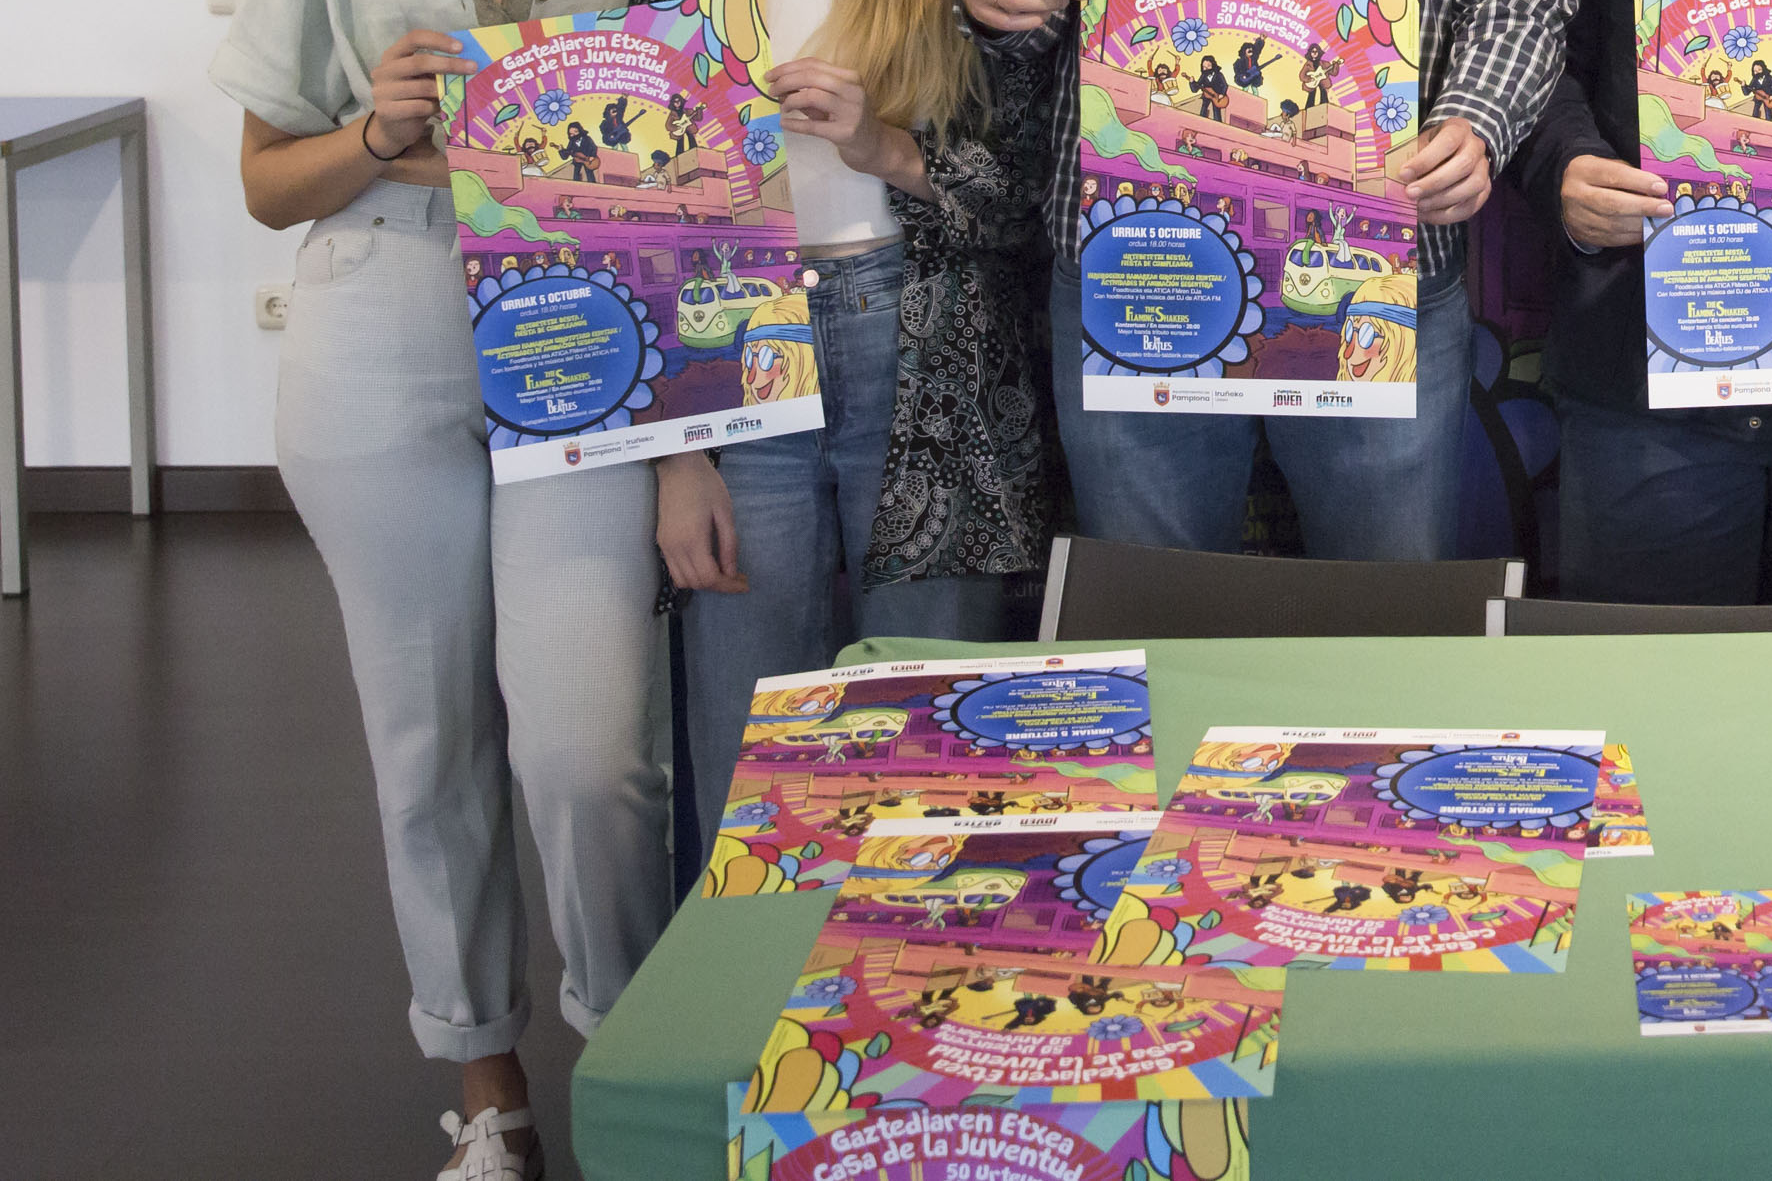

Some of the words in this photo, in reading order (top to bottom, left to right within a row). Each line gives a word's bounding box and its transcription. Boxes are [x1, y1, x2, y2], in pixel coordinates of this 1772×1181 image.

[1219, 0, 1237, 14] 50
[1238, 2, 1310, 39] Urteurrena
[1687, 2, 1727, 24] Casa
[1216, 12, 1234, 25] 50
[1234, 13, 1309, 50] Aniversario
[502, 34, 607, 71] Gaztediaren
[610, 32, 659, 56] Etxea
[493, 67, 535, 94] Casa
[537, 58, 559, 74] de
[561, 50, 580, 67] la
[583, 47, 667, 74] Juventud
[579, 67, 596, 81] 50
[597, 66, 670, 91] Urteurrena
[576, 77, 593, 91] 50
[594, 77, 670, 101] Aniversario
[1111, 226, 1147, 238] URRIAK
[1149, 227, 1156, 238] 5
[1157, 226, 1202, 239] OCTUBRE
[1672, 224, 1707, 236] URRIAK
[1707, 224, 1715, 235] 5
[1716, 222, 1758, 235] OCTUBRE
[500, 295, 538, 311] URRIAK
[538, 294, 546, 305] 5
[547, 285, 592, 304] OCTUBRE
[831, 1108, 993, 1152] Gaztediaren
[1000, 1112, 1075, 1156] Etxea
[813, 1151, 877, 1181] Casa
[883, 1137, 915, 1165] de
[923, 1132, 949, 1157] la
[955, 1132, 1083, 1181] Juventud
[946, 1163, 971, 1180] 50
